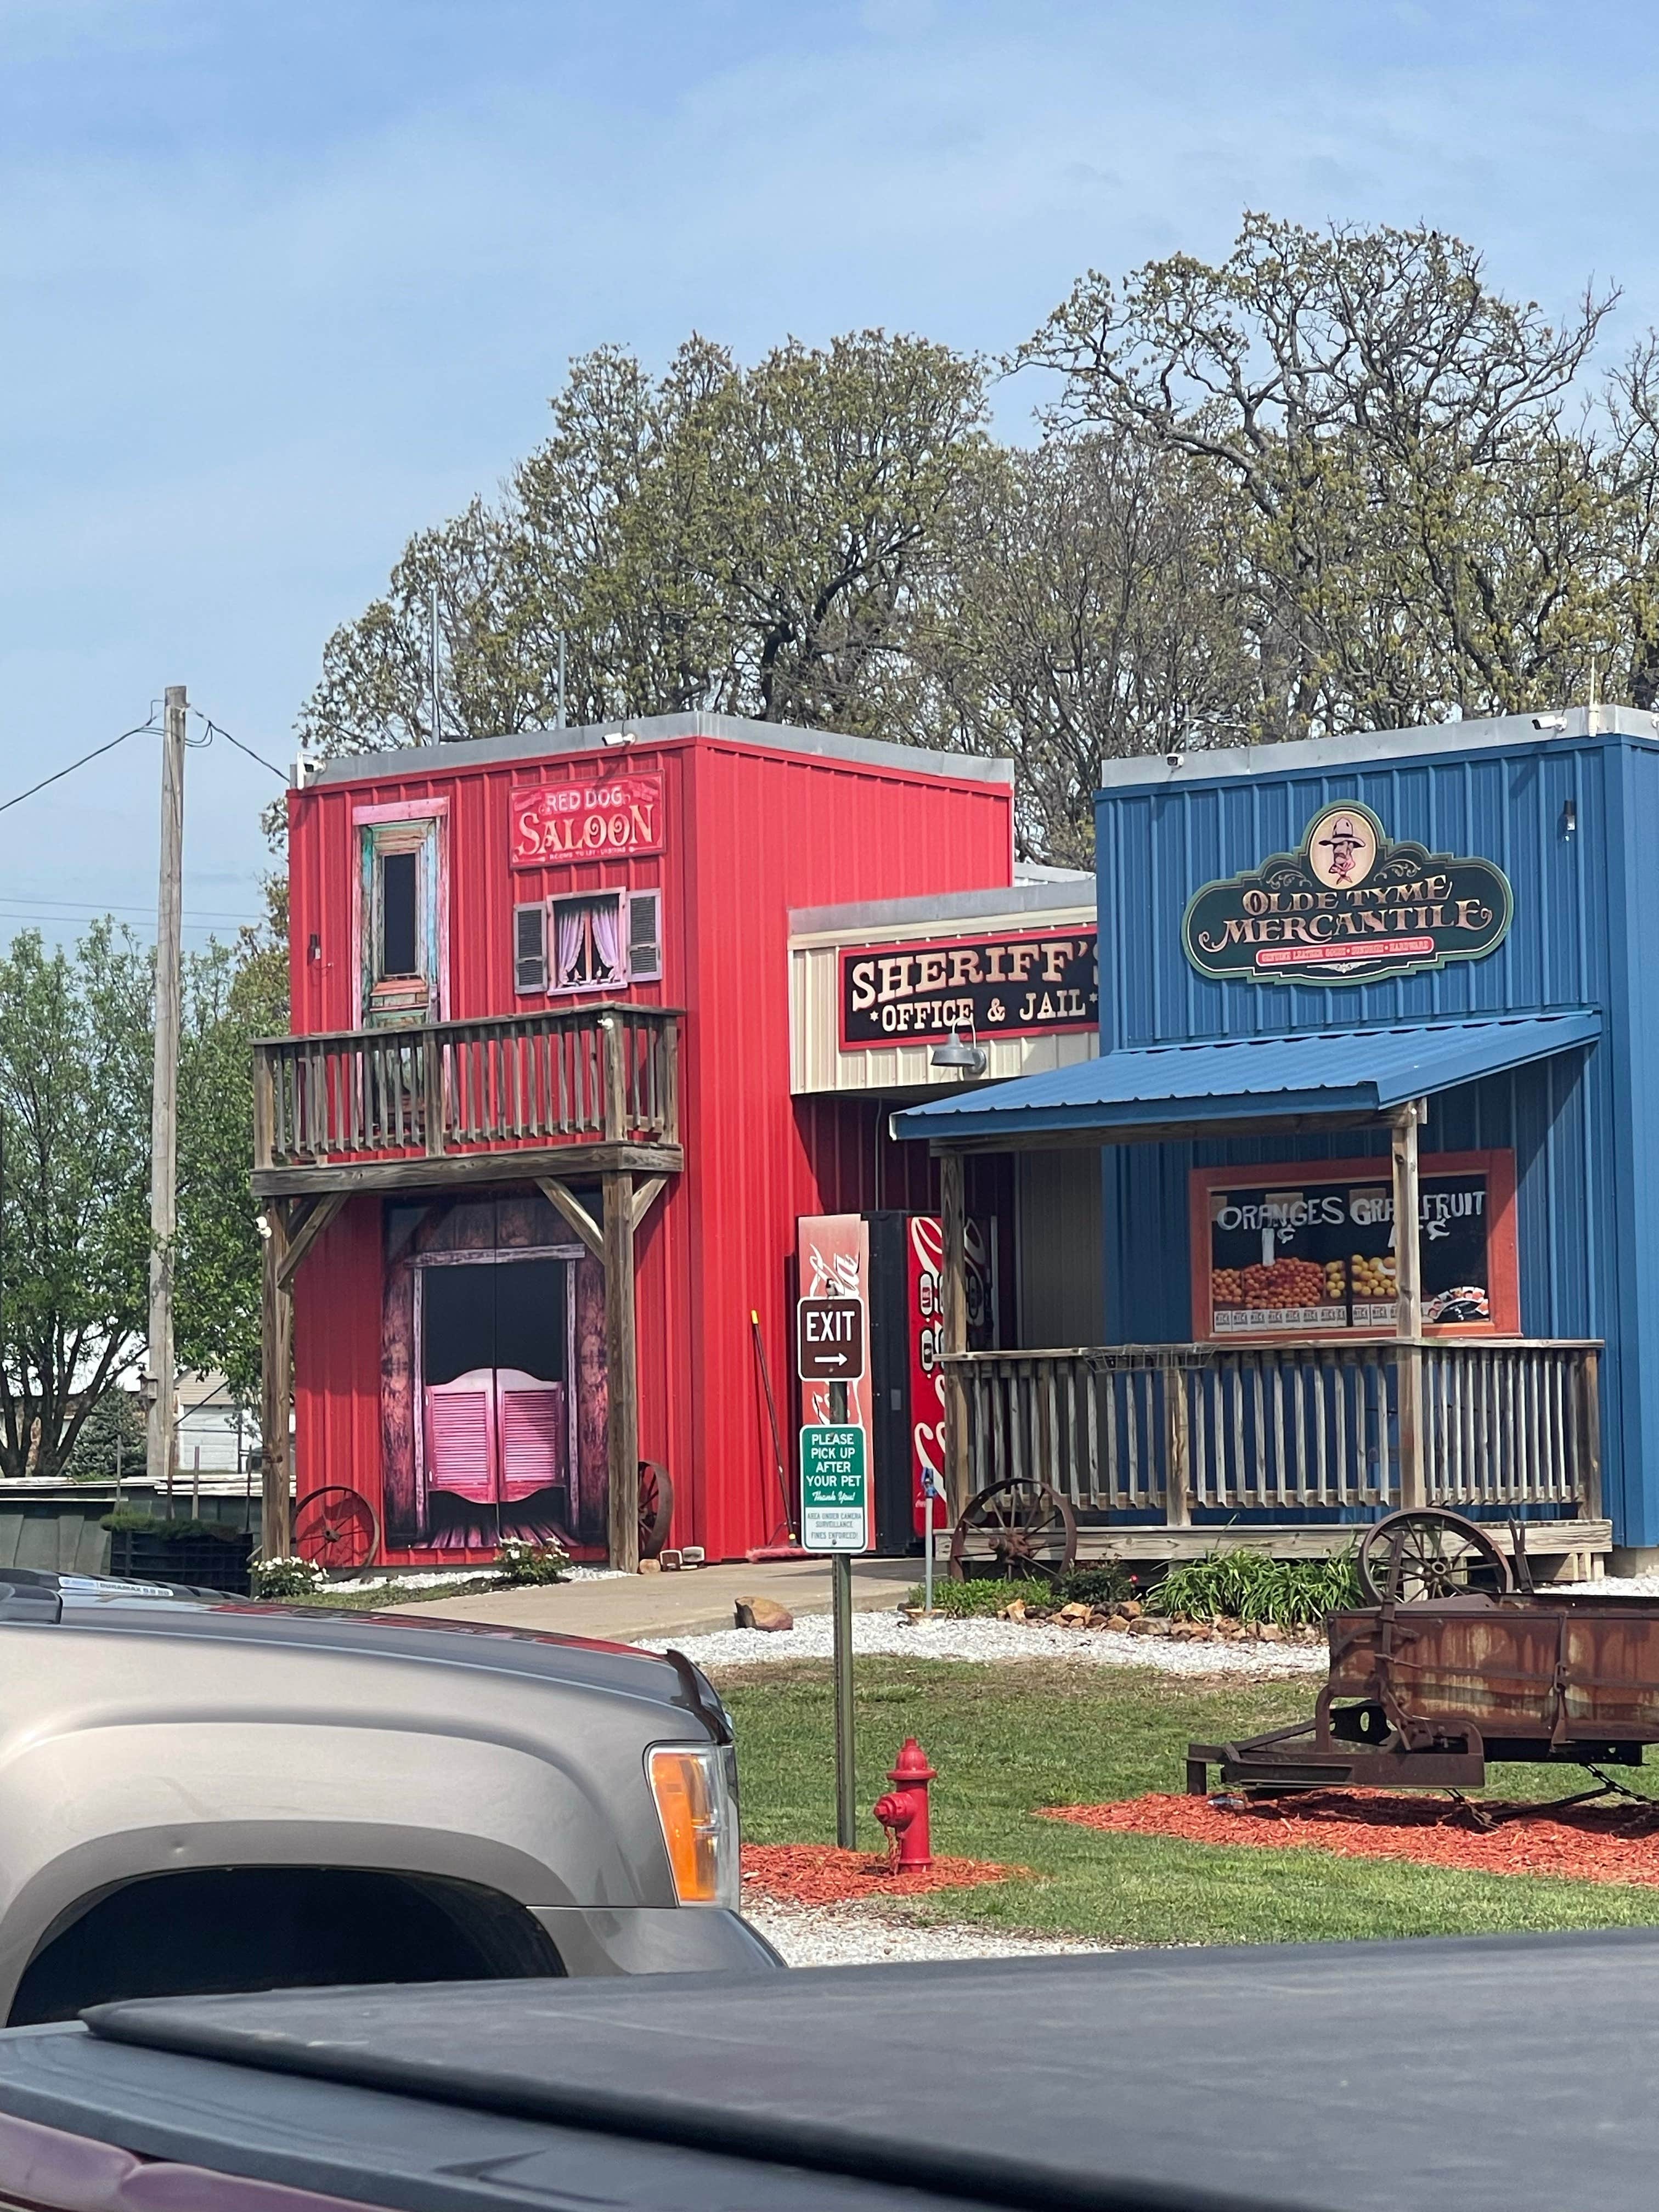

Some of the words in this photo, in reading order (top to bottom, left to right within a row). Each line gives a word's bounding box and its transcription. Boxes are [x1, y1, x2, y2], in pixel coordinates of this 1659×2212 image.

[547, 791, 582, 812] RED
[584, 786, 623, 808] DOG
[515, 804, 654, 855] SALOON
[1242, 889, 1340, 916] OLDE
[1346, 874, 1453, 907] TYME
[1199, 899, 1493, 953] MERCANTILE
[882, 998, 974, 1032] OFFICE
[987, 997, 1005, 1023] &
[1019, 989, 1086, 1021] JAIL
[1216, 1196, 1345, 1231] ORANGES
[805, 1311, 855, 1342] EXIT
[811, 1433, 855, 1445] PLEASE
[811, 1447, 836, 1459] PICK
[839, 1447, 856, 1459] UP
[815, 1461, 851, 1473] AFTER
[806, 1475, 837, 1487] YOUR
[840, 1475, 861, 1487] PET
[812, 1490, 836, 1502] Thank
[811, 1531, 826, 1539] FINES
